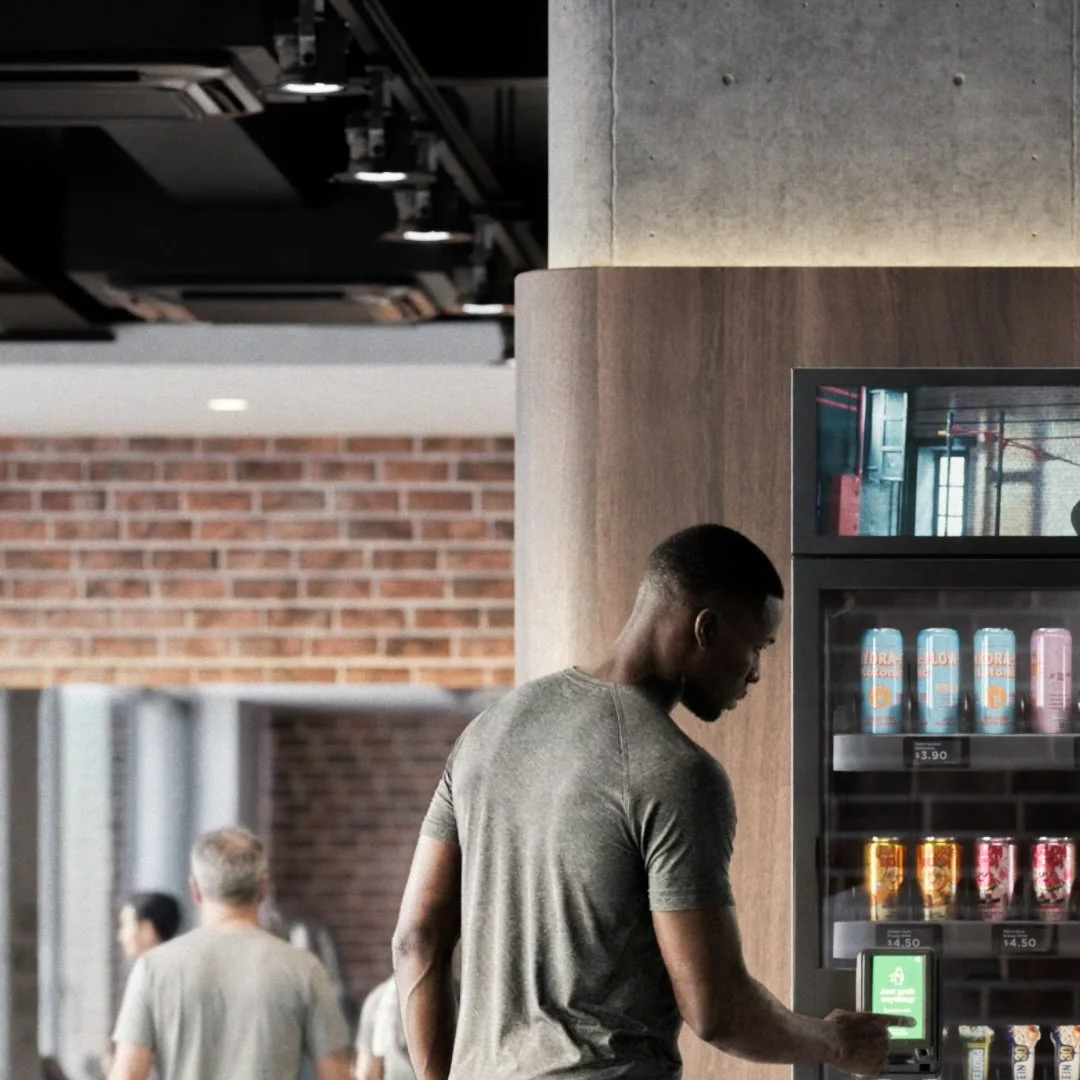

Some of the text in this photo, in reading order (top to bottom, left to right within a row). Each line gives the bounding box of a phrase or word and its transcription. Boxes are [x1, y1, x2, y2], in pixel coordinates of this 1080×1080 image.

[914, 750, 948, 761] $3.90
[887, 938, 920, 948] $4.50
[1003, 938, 1036, 948] $4.50
[1015, 1045, 1028, 1061] 30
[1060, 1045, 1073, 1061] 30
